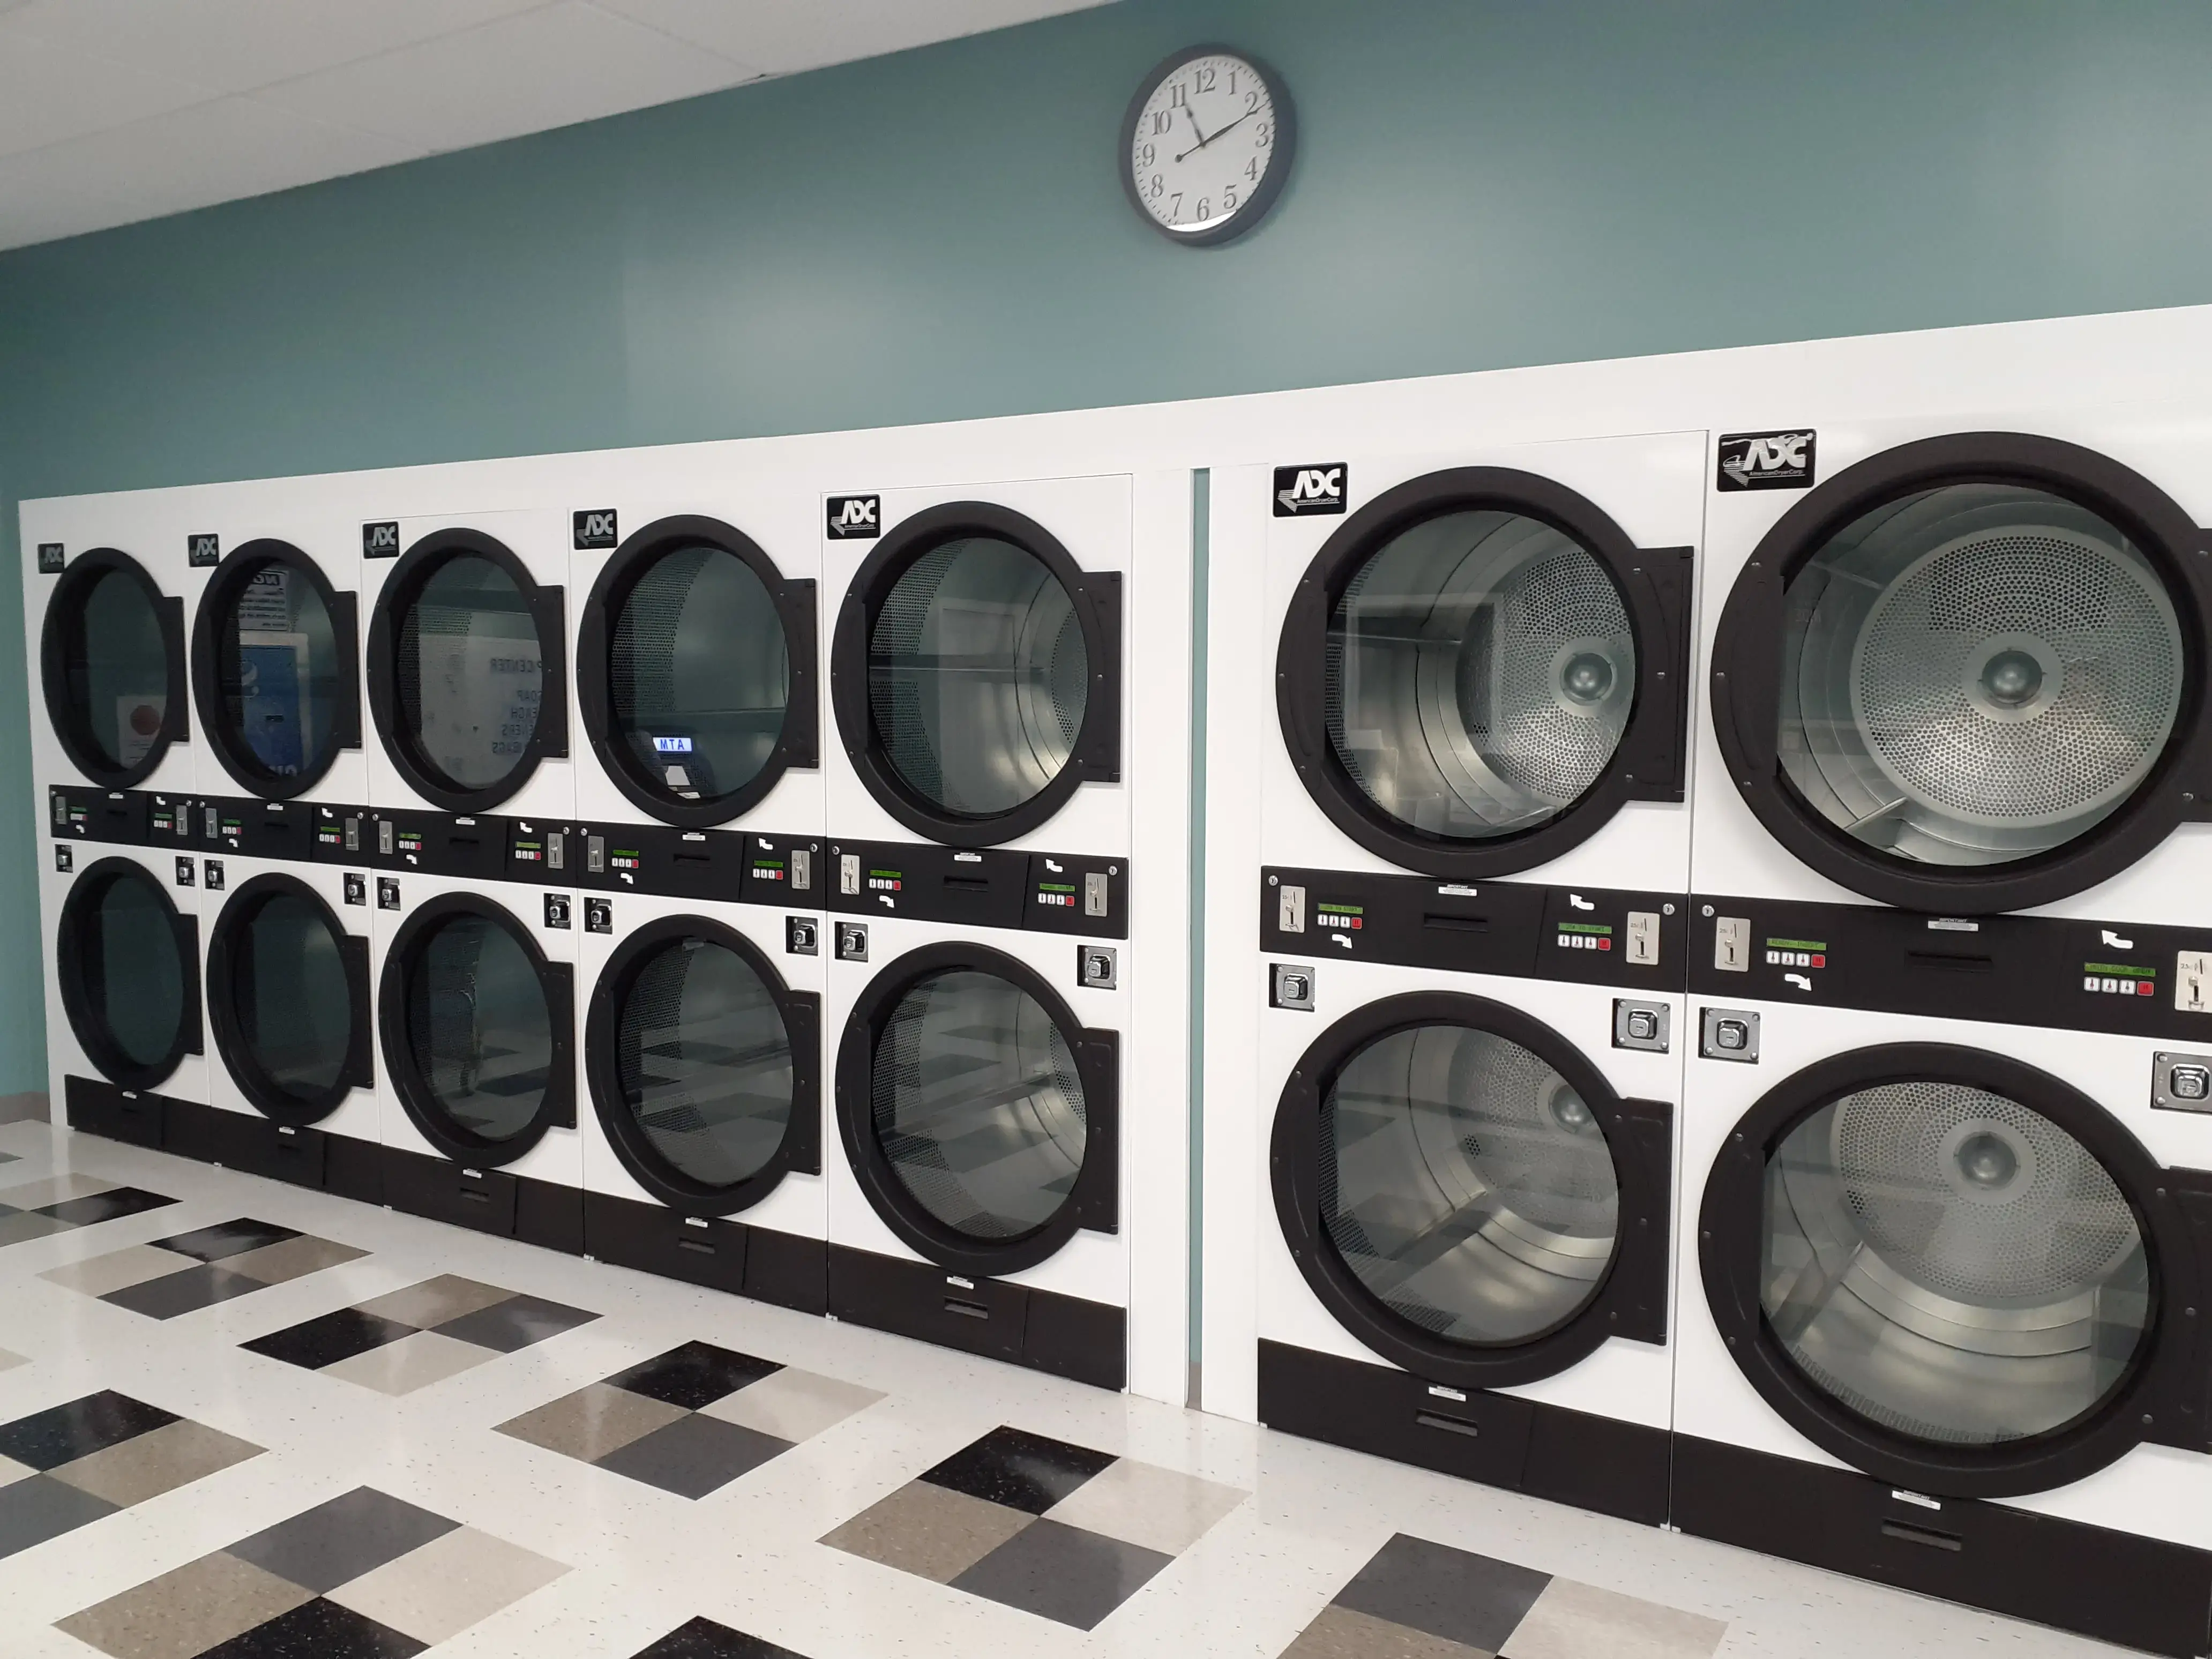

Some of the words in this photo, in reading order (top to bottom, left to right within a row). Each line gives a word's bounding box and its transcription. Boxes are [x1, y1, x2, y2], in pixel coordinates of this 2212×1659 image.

[1194, 68, 1215, 94] 12
[1228, 71, 1237, 95] 1
[1170, 83, 1187, 109] 11
[1245, 91, 1259, 114] 2
[1152, 110, 1171, 136] 10
[1256, 123, 1268, 147] 3
[1142, 144, 1155, 167] 9
[1244, 156, 1257, 181] 4
[1150, 174, 1163, 198] 8
[1224, 184, 1236, 208] 5
[1170, 192, 1183, 218] 7
[1197, 197, 1210, 222] 6
[1743, 436, 1807, 470] ADC
[1292, 468, 1341, 498] ADC
[841, 499, 876, 524] ADC
[372, 526, 396, 546] ADC
[585, 513, 614, 536] ADC
[196, 537, 216, 556] ADC
